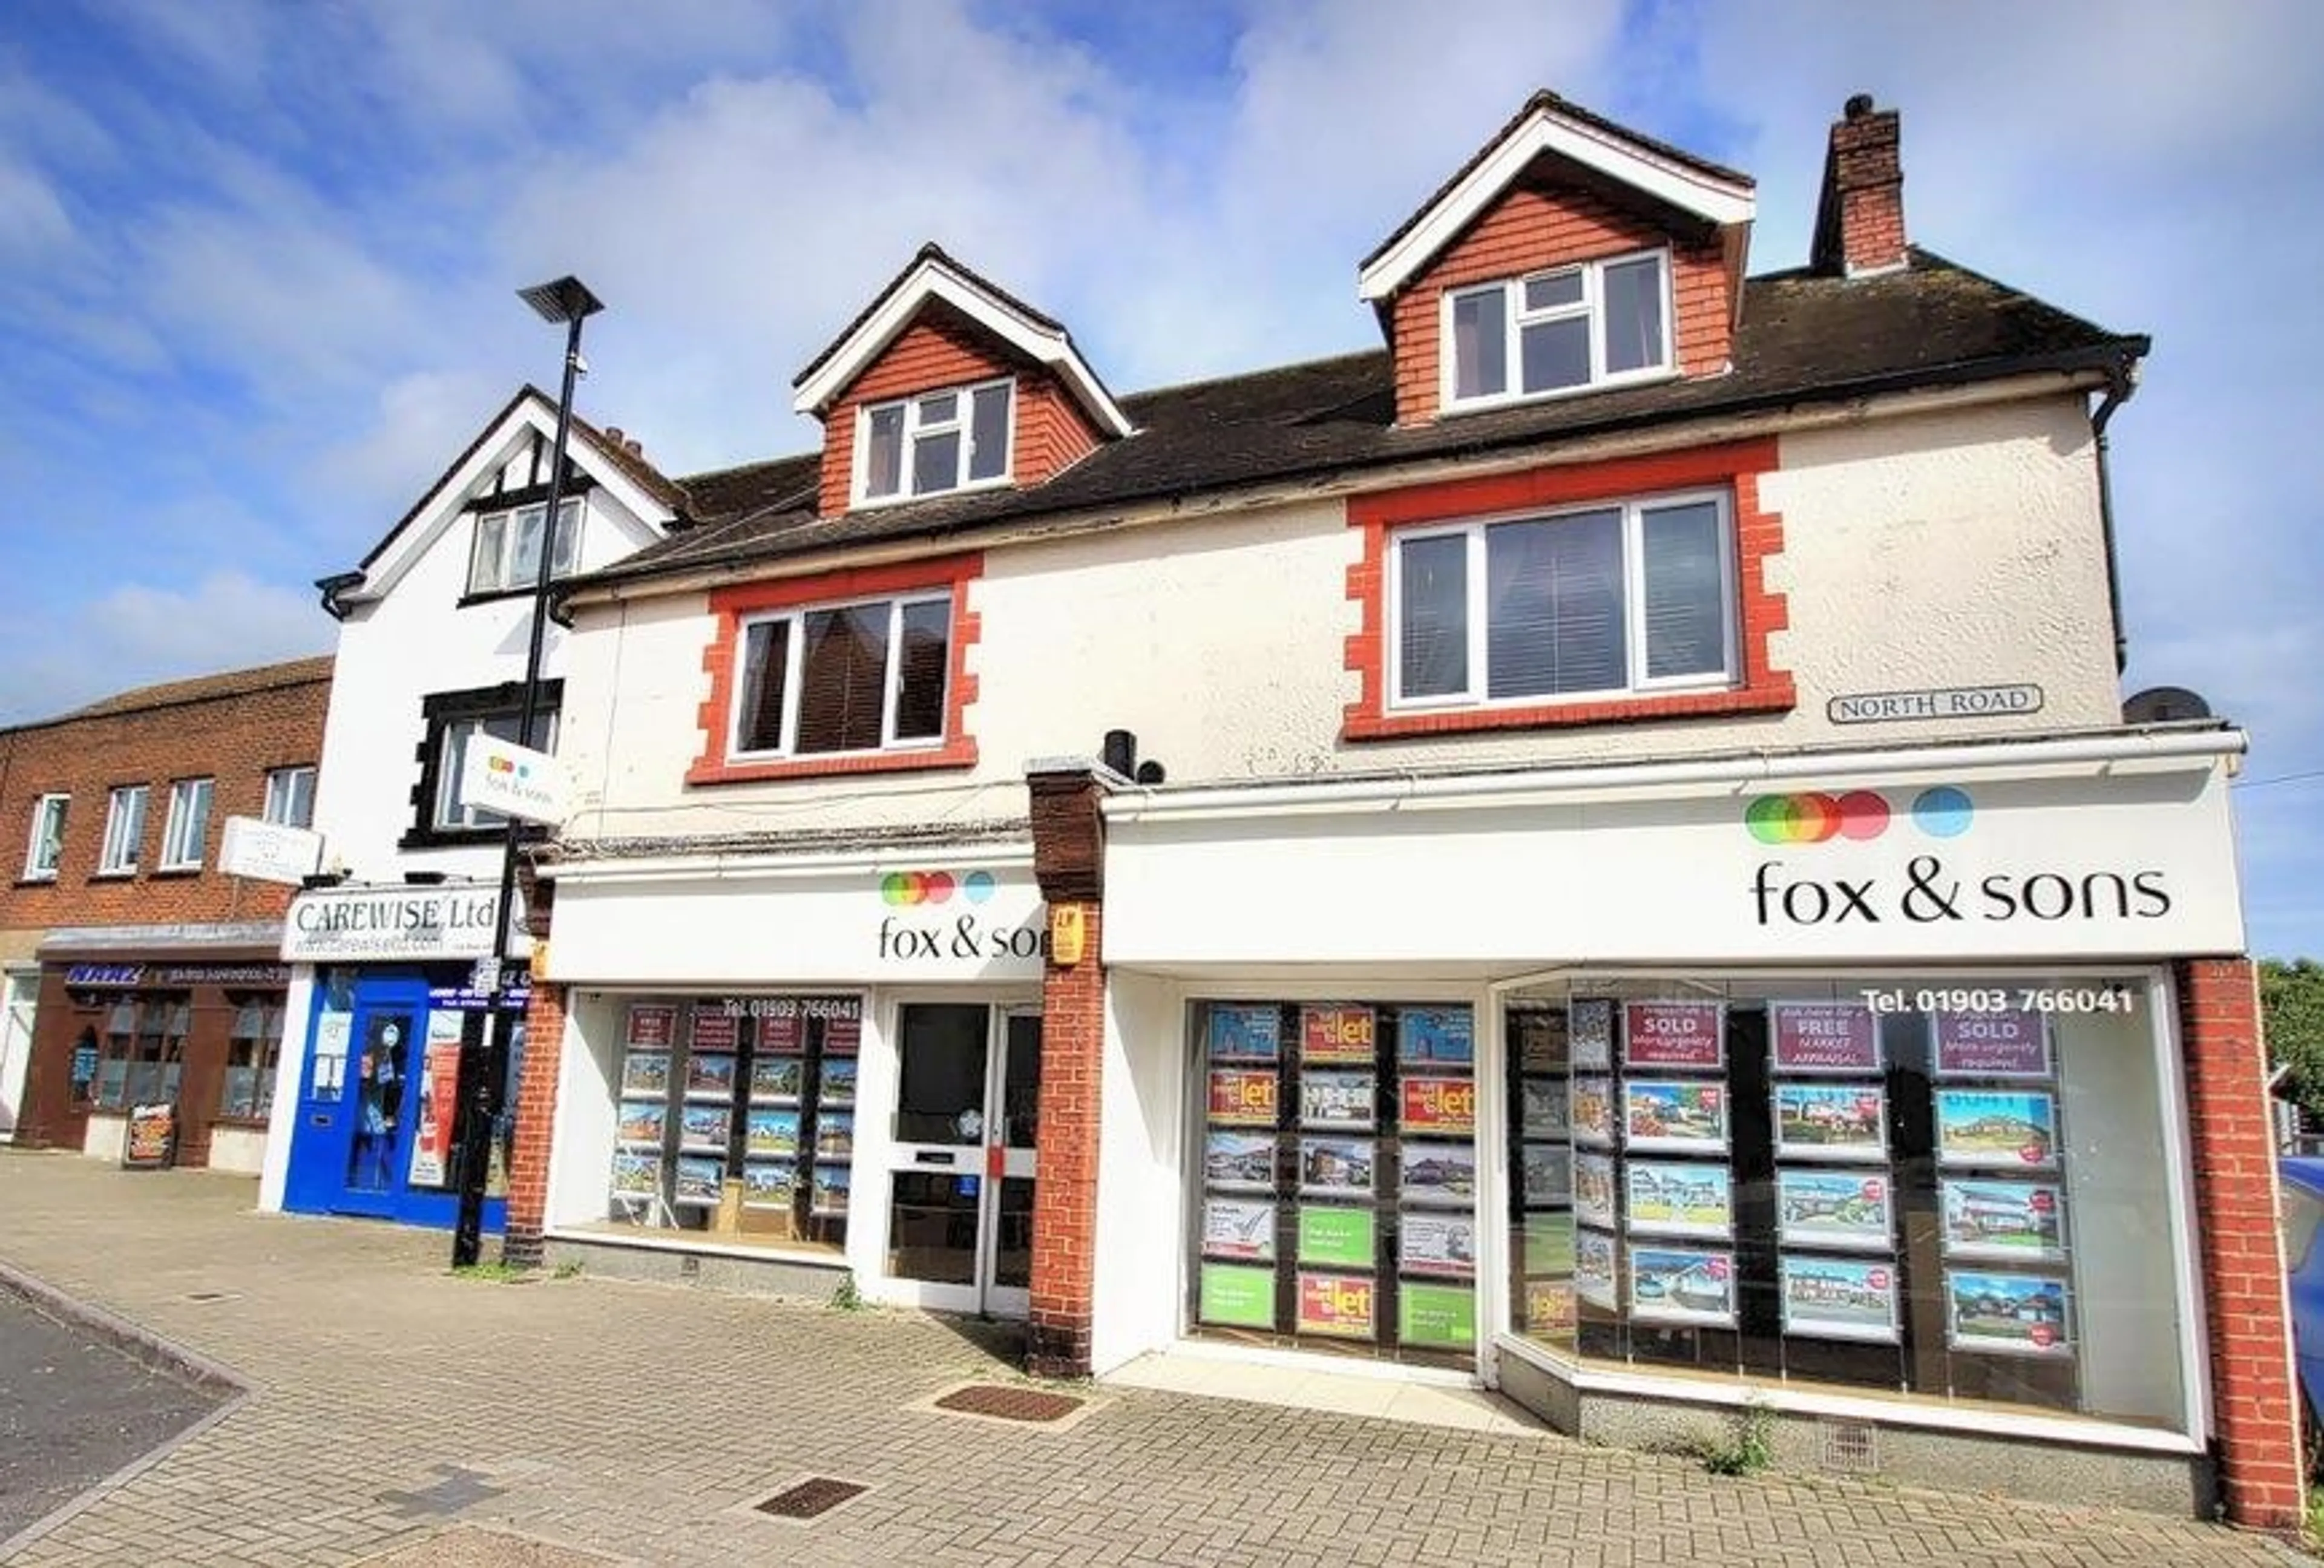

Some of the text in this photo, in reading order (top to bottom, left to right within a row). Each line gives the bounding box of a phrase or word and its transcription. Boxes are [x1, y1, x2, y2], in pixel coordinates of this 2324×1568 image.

[1840, 691, 2029, 720] NORTH ROAD
[1748, 854, 2171, 925] fox & sons
[297, 897, 496, 931] CAREWISE Ltd
[879, 916, 942, 959] fox
[951, 913, 982, 959] &
[991, 927, 1048, 958] so
[750, 1000, 798, 1017] 01903
[801, 1000, 859, 1020] 766041
[1861, 989, 2133, 1013] Tel. 01903 766041
[1338, 1010, 1371, 1045] let
[1644, 1017, 1698, 1034] SOLD
[1797, 1019, 1850, 1035] FREE
[1958, 1021, 2019, 1038] SOLD
[1240, 1077, 1275, 1106] let
[1437, 1082, 1474, 1115] let
[1334, 1281, 1371, 1317] let
